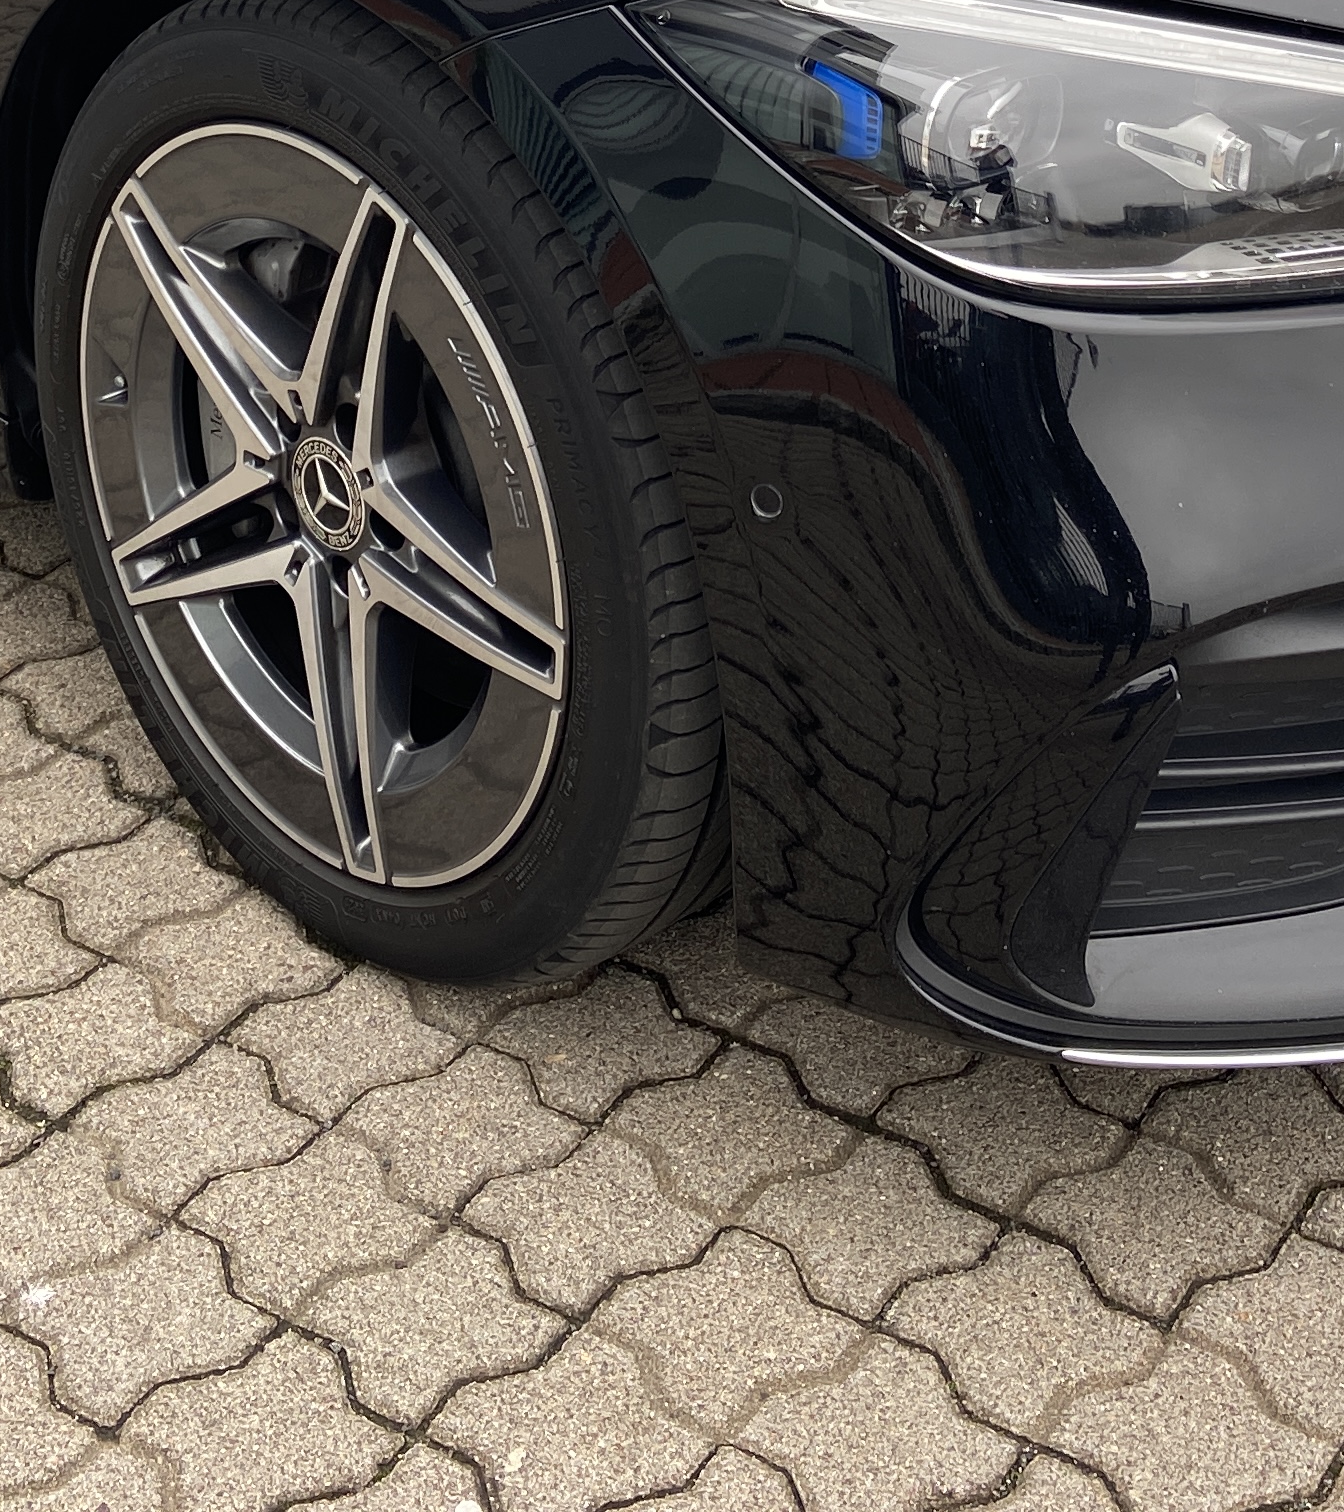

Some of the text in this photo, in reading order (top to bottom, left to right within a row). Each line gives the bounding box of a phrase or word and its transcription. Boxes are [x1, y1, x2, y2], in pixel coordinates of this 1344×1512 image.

[317, 88, 537, 345] MICHELIN
[210, 407, 223, 440] Me
[296, 442, 338, 468] MERCEDES
[328, 531, 353, 547] BENZ
